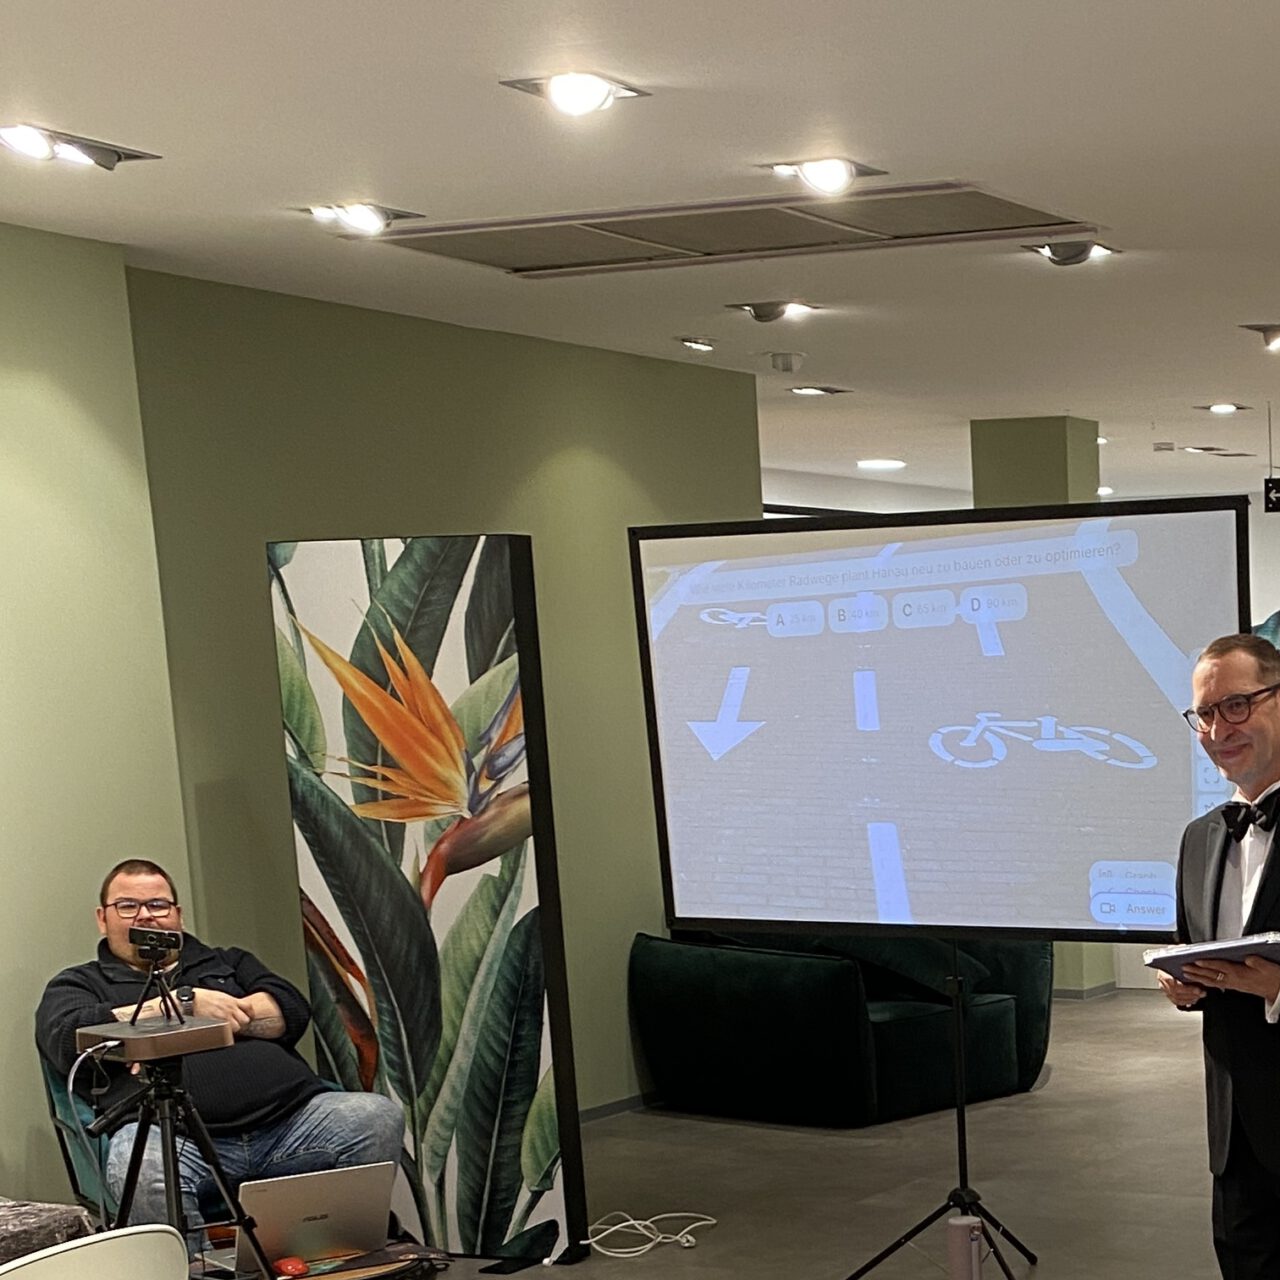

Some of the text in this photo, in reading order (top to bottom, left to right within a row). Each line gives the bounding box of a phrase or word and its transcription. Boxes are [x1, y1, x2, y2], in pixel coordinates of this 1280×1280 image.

[789, 570, 839, 588] Radwege
[841, 568, 869, 585] plant
[872, 565, 909, 579] Hanau
[911, 565, 934, 577] neu
[937, 563, 951, 574] zu
[953, 558, 992, 573] bauen
[994, 554, 1024, 568] oder
[1026, 552, 1042, 564] zu
[1045, 542, 1121, 566] optimieren?
[902, 603, 913, 617] C
[970, 597, 982, 612] D
[986, 598, 1000, 610] 90
[775, 613, 786, 627] A
[837, 608, 847, 623] B
[1126, 903, 1166, 915] Answer
